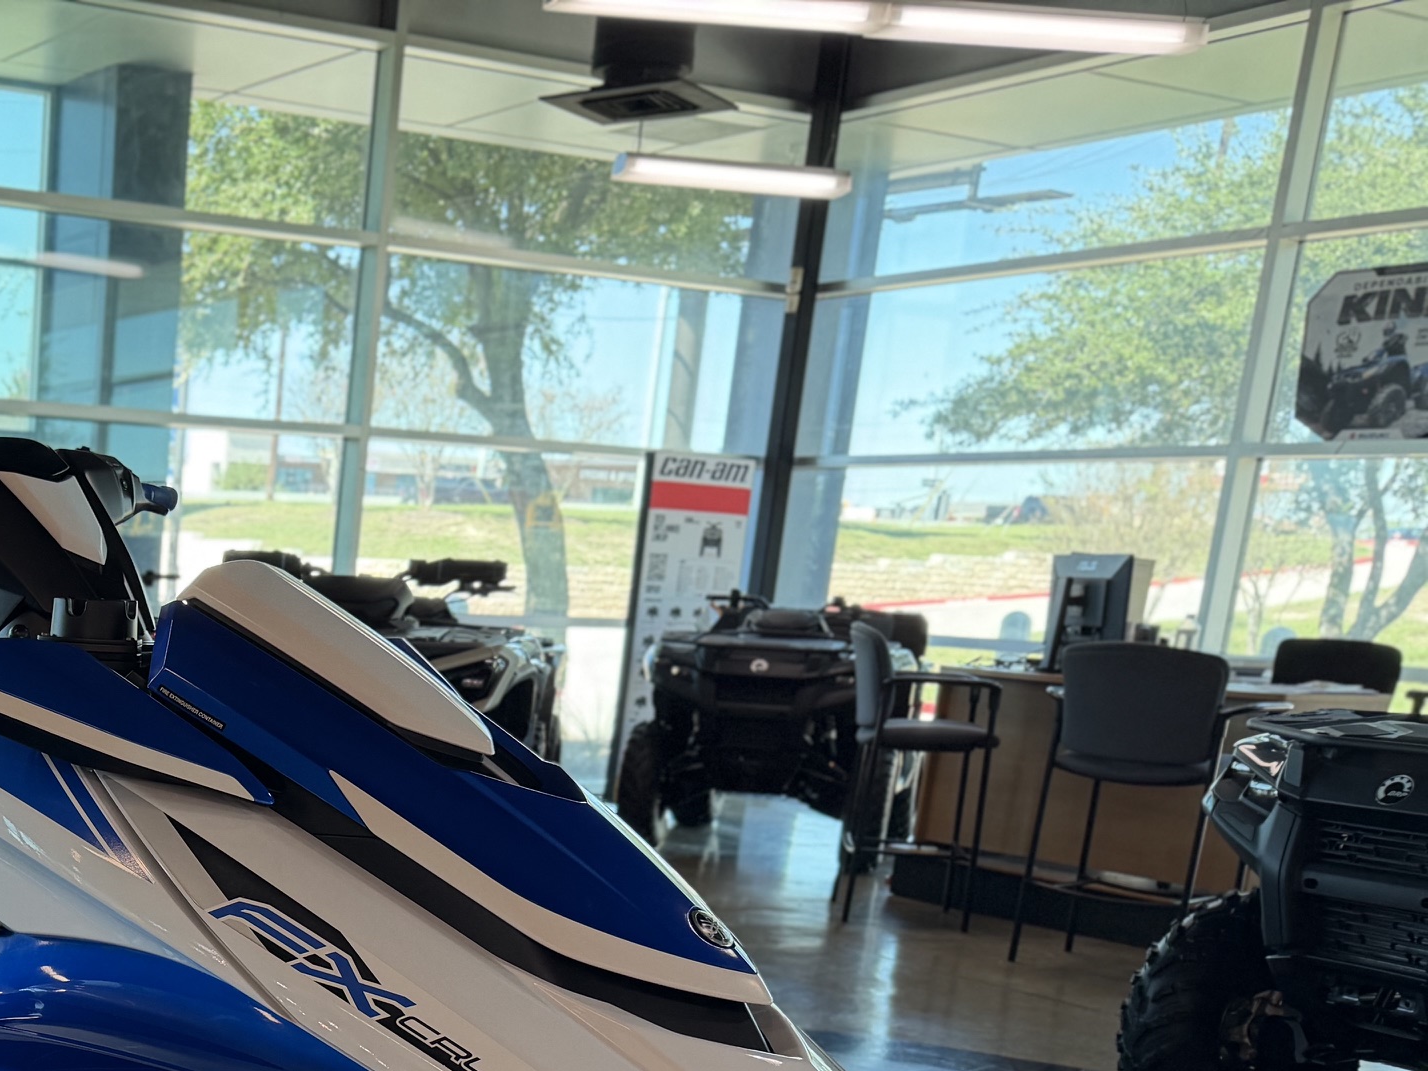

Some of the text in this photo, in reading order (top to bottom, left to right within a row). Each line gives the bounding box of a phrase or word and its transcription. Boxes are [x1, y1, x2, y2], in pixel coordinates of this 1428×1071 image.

[1337, 286, 1428, 326] KIN
[659, 456, 750, 483] can-am
[159, 686, 224, 730] FIRE EXTINGUISHER CONTAINER
[208, 901, 417, 1018] FX
